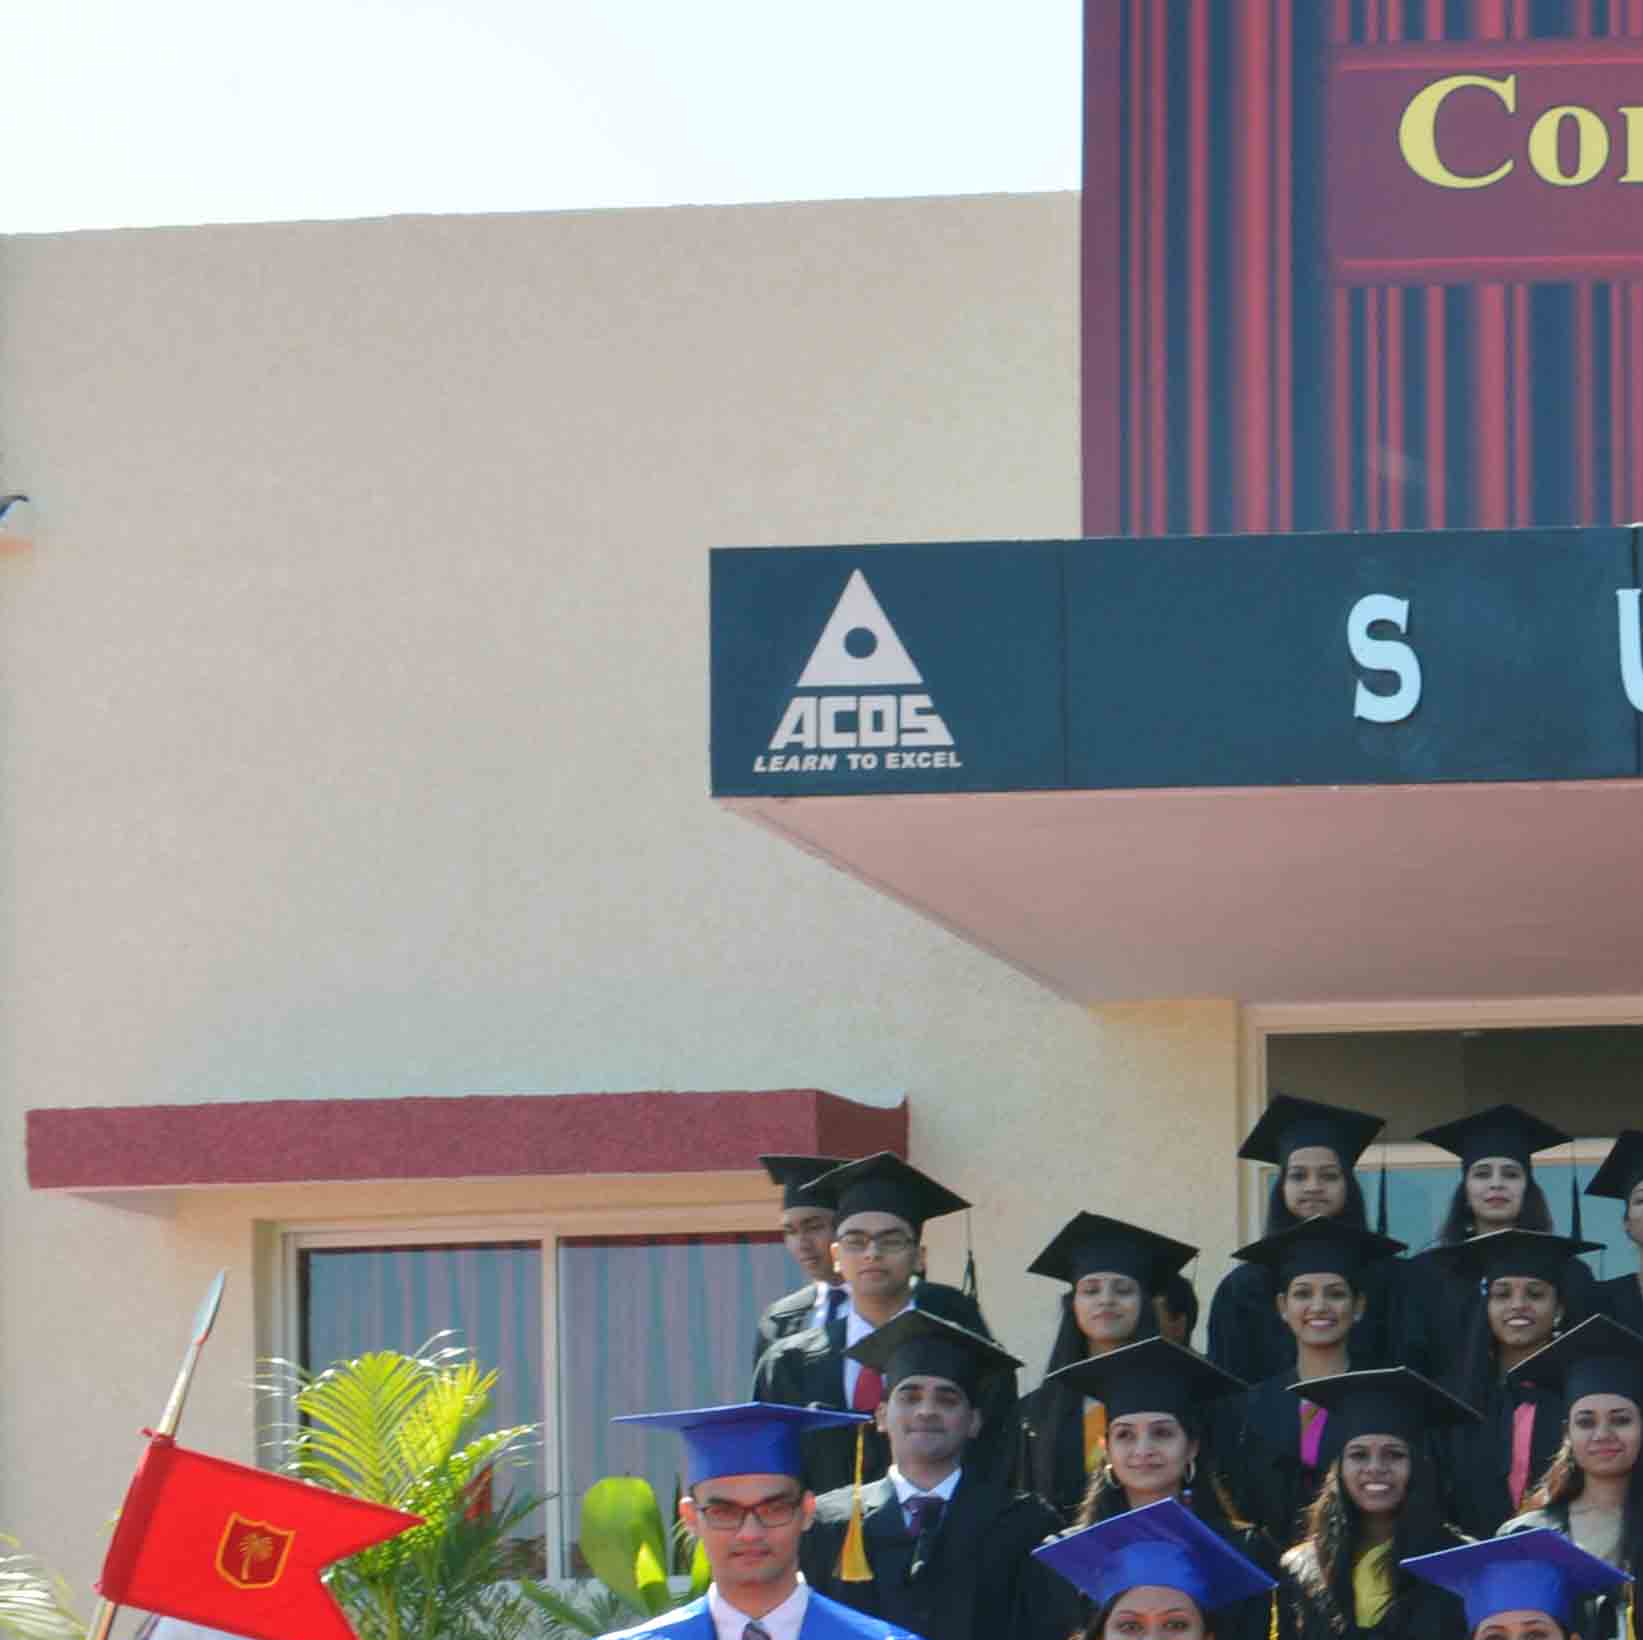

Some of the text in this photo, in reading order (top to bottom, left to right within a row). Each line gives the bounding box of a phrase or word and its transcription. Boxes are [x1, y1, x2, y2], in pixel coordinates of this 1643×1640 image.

[768, 694, 955, 751] ACOS
[752, 751, 963, 773] LEARN TO EXCEL
